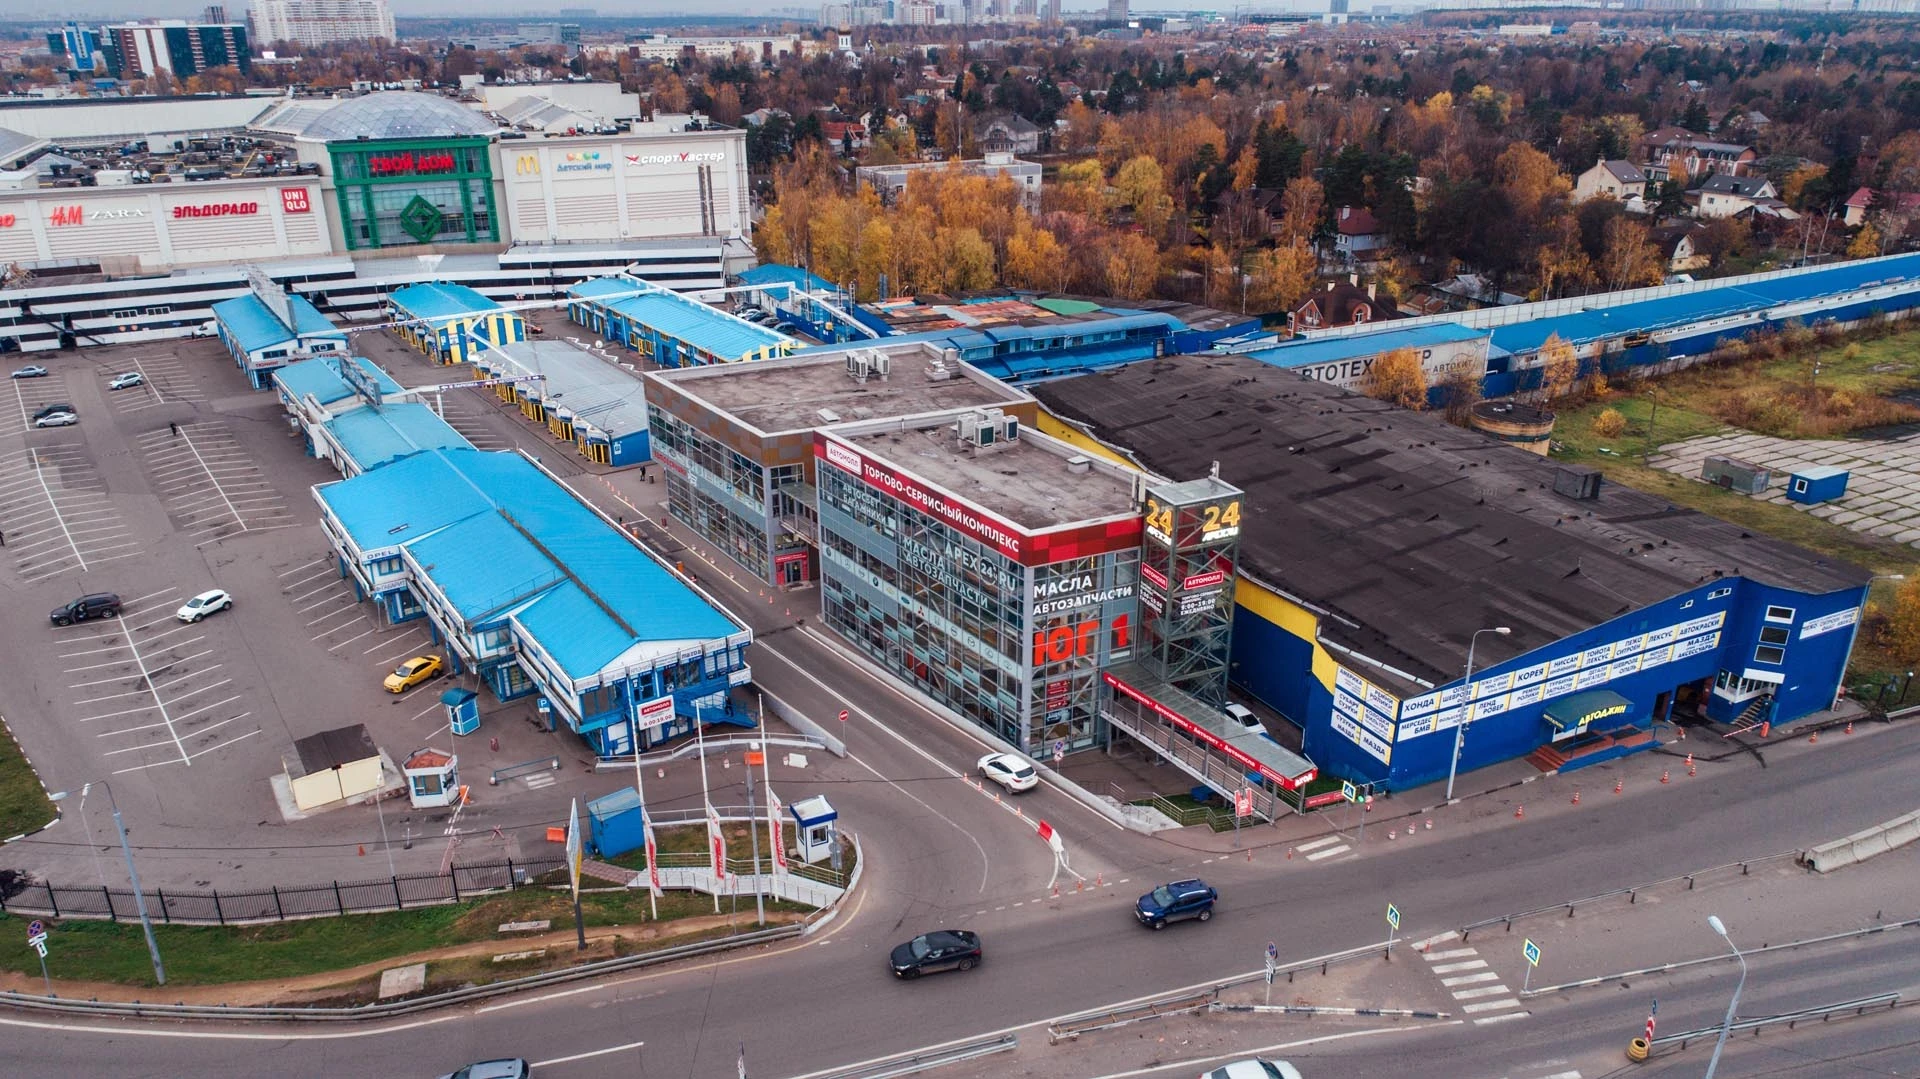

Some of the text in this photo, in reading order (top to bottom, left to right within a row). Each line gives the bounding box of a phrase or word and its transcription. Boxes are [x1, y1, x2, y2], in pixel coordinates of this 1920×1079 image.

[369, 152, 454, 172] ТВОЙ ДОМ
[284, 191, 304, 200] UNI
[173, 202, 258, 219] ЭЛЬДОРАДО
[286, 201, 306, 210] QLO
[49, 205, 83, 226] H&M
[90, 207, 145, 220] ZARA
[829, 448, 859, 467] АВТОМОЛЛ
[843, 484, 879, 508] АВТОСВЕТ
[864, 464, 1019, 552] ТОРГОВО-СЕРВИСНЫЙ КОМПЛЕКС
[1147, 499, 1173, 536] 24
[1202, 501, 1241, 532] 24
[367, 550, 394, 559] OPEL
[904, 536, 945, 570] МАСЛА
[905, 552, 988, 608] АВТОЗАПЧАСТИ
[1143, 567, 1166, 585] АВТОМОЛЛ
[1188, 575, 1220, 586] АВТОМОЛЛ
[1033, 575, 1092, 598] МАСЛА
[1033, 586, 1132, 615] АВТОЗАПЧАСТИ
[1679, 619, 1720, 635] АВТОКРАСКИ
[1034, 613, 1128, 666] ЮГ 1
[1649, 630, 1673, 642] ЛЕКСУС
[1687, 633, 1716, 646] МАЗДА
[1587, 646, 1610, 657] ТОЙОТА
[1616, 644, 1641, 655] СИТРОЕН
[1554, 655, 1578, 667] НИССАН
[1586, 654, 1608, 664] ЛЕКСУС
[1518, 668, 1544, 681] КОРЕЯ
[1339, 693, 1359, 708] СУБАРУ
[1370, 693, 1393, 710] РОЛИКИ
[1517, 691, 1539, 701] РОЛИКИ
[643, 702, 670, 713] АВТОМОЛЛ
[1338, 700, 1358, 714] СУЗУКИ
[1404, 698, 1434, 712] ХОНДА
[1479, 699, 1496, 709] ЛЕНД
[1483, 703, 1504, 714] РОВЕР
[1336, 714, 1356, 729] СУЗУКИ
[1401, 716, 1432, 729] МЕРСЕДЕС
[1577, 704, 1627, 726] АВТОДЖИН
[1337, 722, 1355, 739] МАЗДА
[1414, 724, 1431, 734] БМВ
[1363, 737, 1385, 755] МАЗДА
